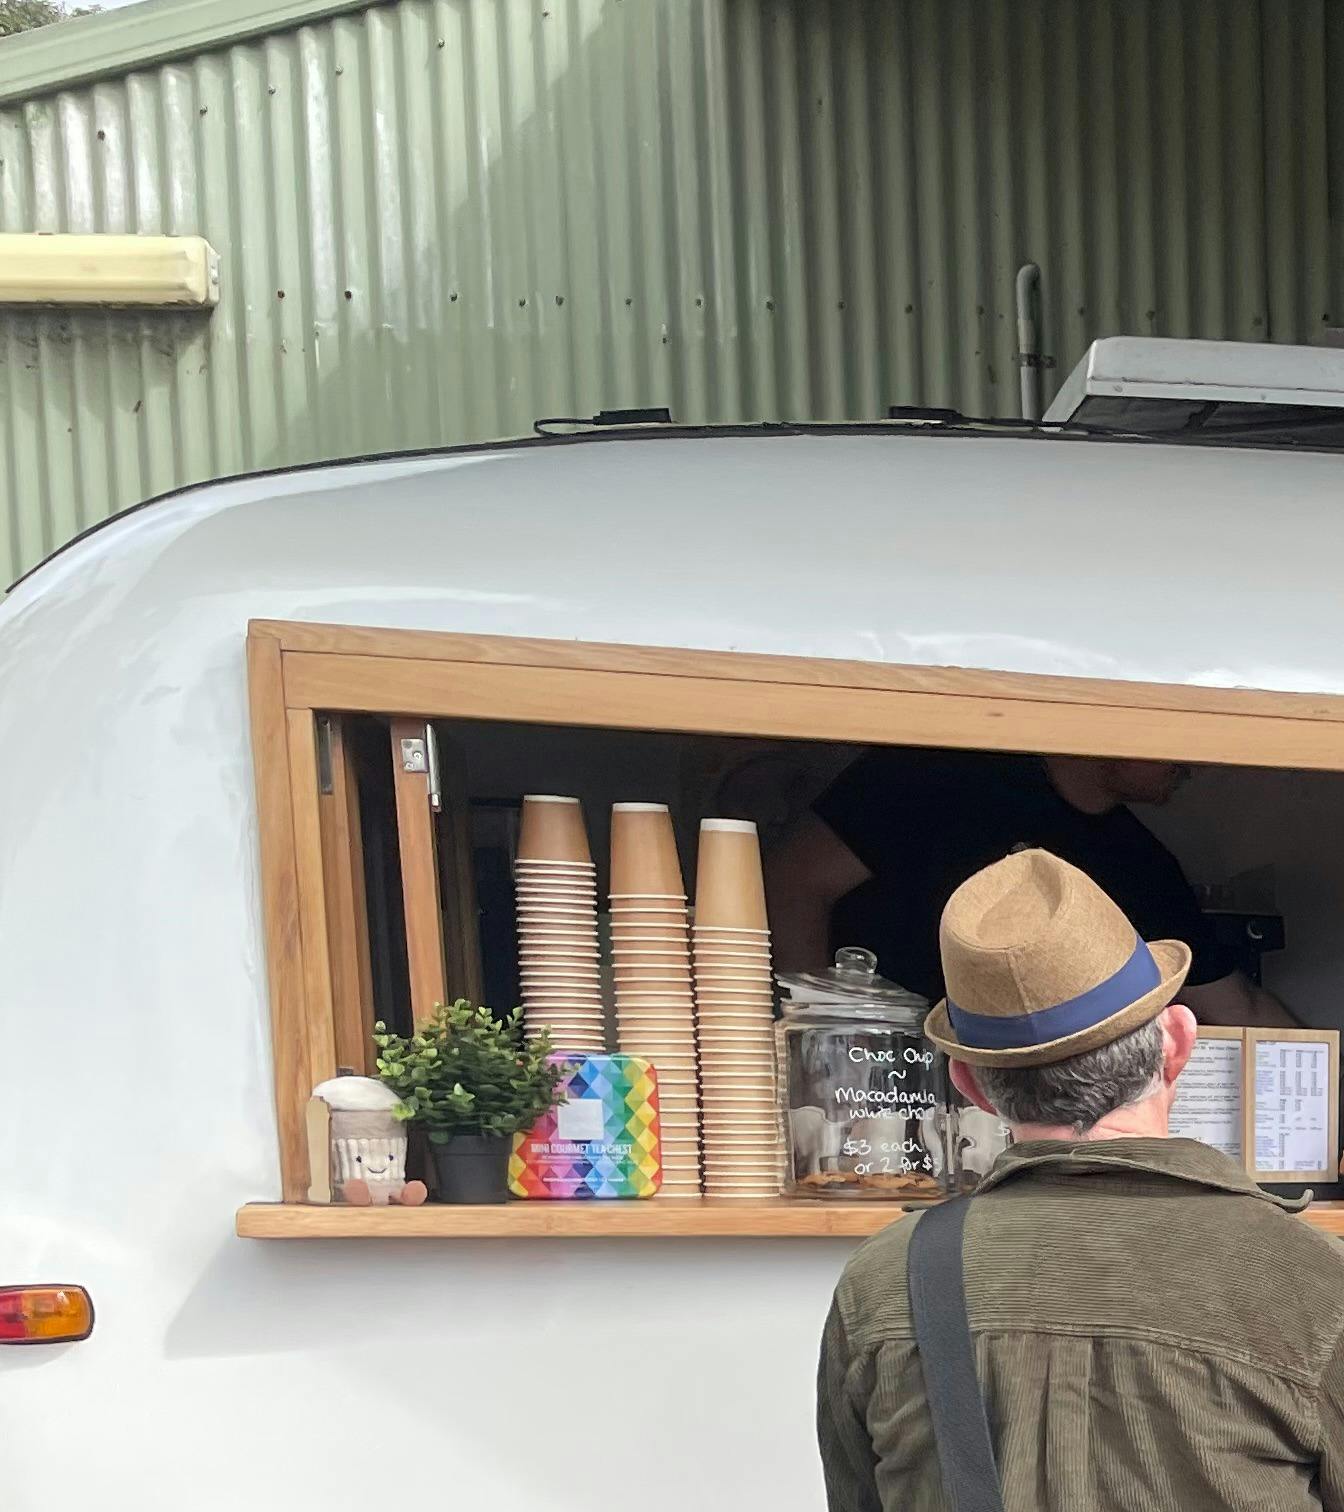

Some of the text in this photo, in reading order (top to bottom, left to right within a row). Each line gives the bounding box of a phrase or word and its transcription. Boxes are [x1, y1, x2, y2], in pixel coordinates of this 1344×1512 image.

[848, 1046, 896, 1064] Choc
[834, 1086, 937, 1105] Macadamia
[842, 1137, 923, 1157] $3 each
